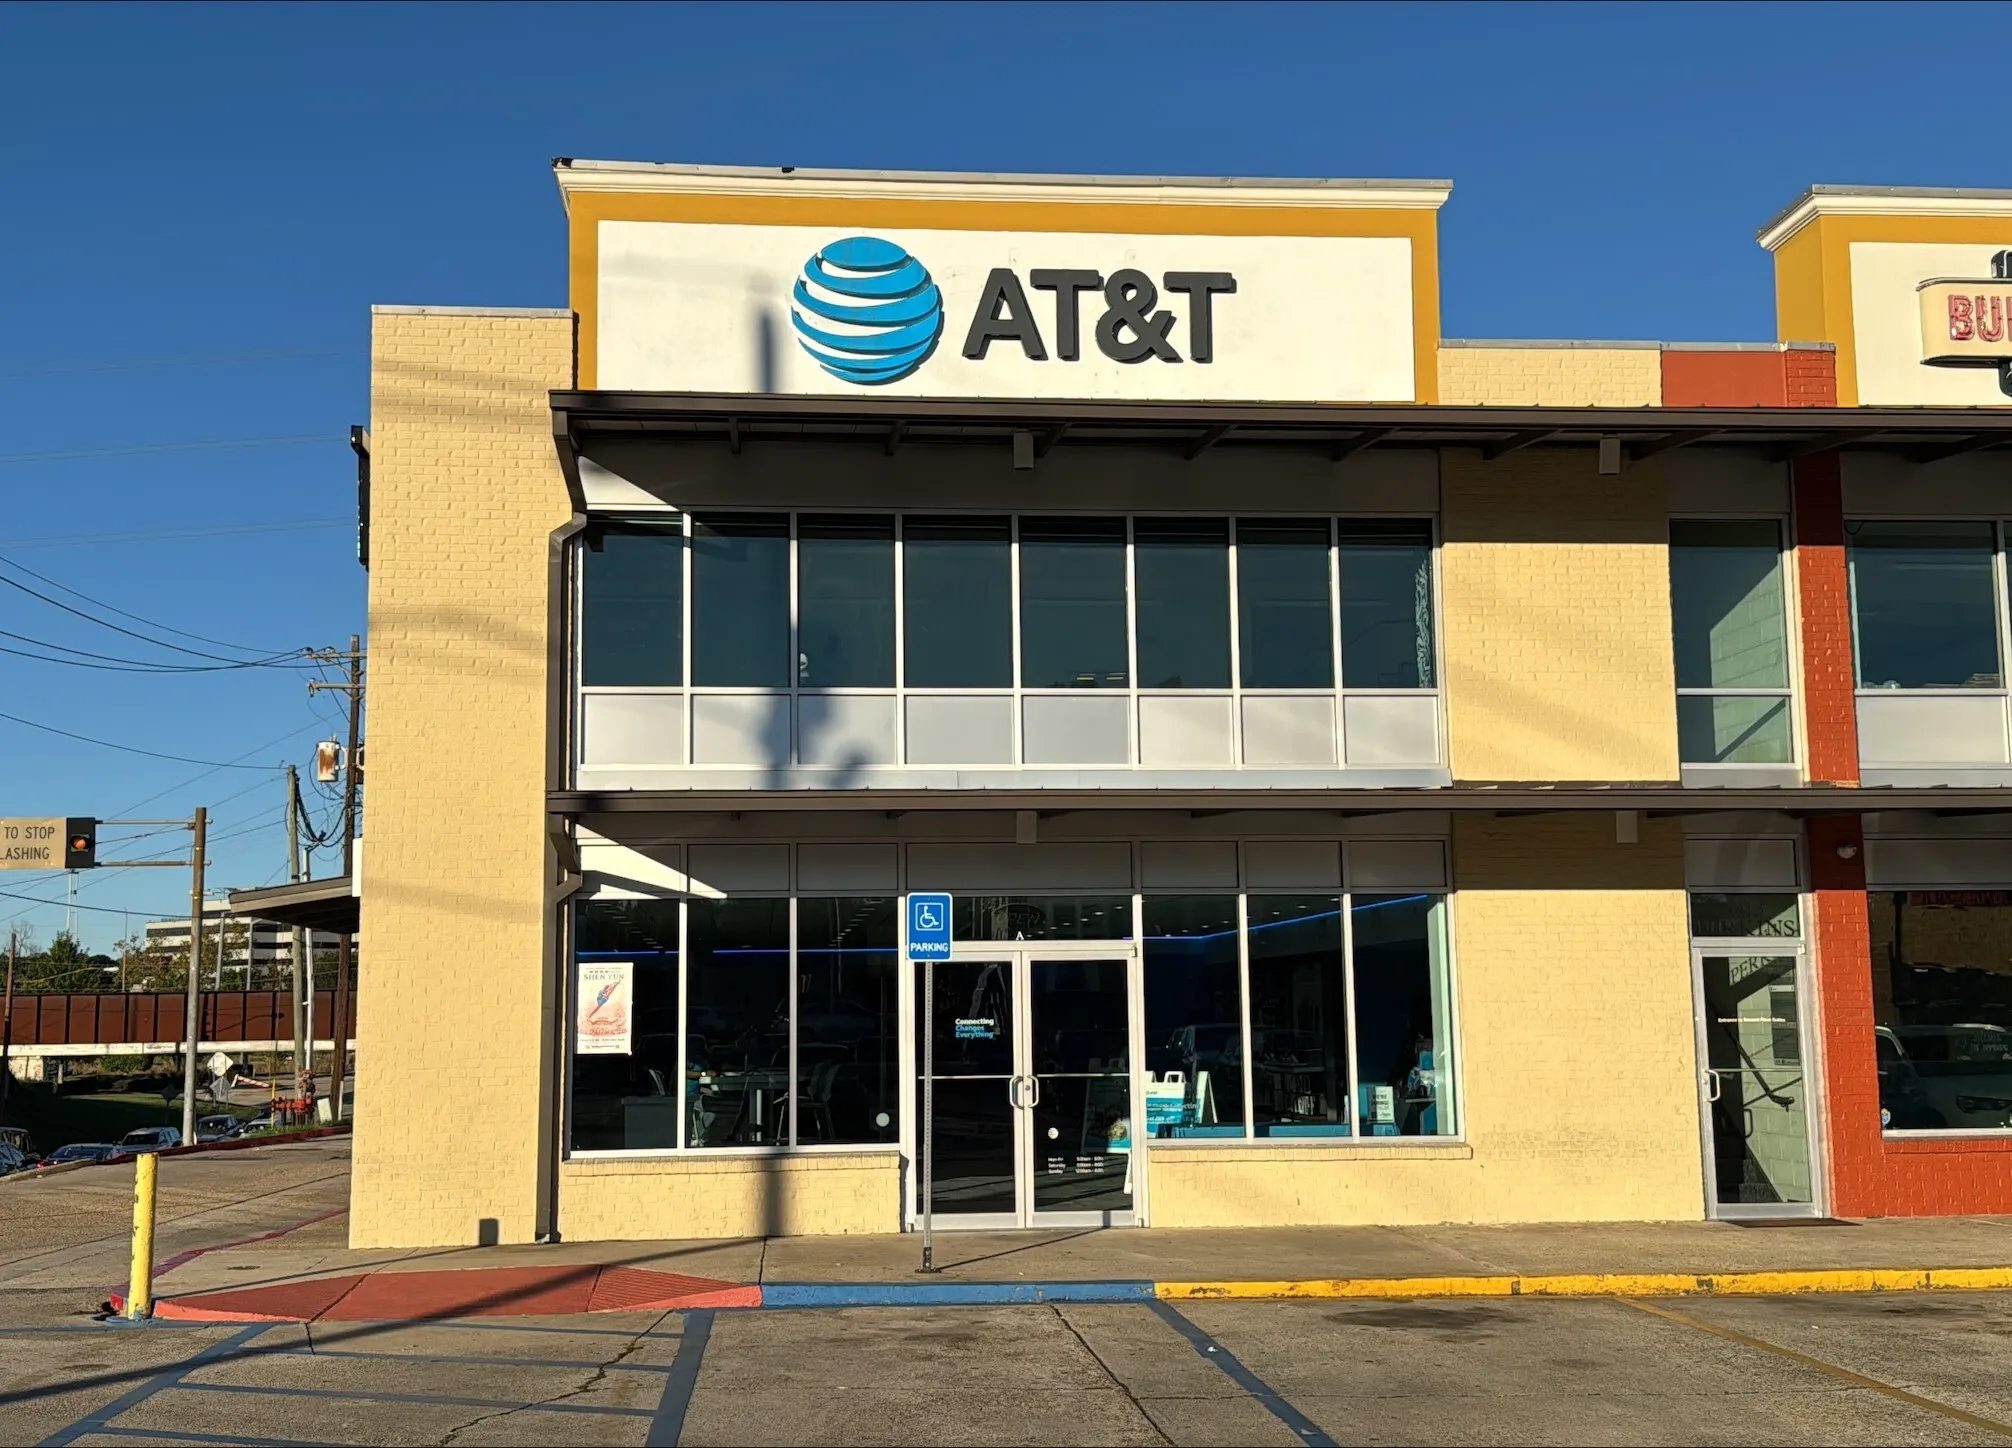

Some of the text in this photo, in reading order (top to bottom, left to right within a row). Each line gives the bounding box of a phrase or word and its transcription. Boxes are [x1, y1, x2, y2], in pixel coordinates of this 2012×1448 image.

[962, 268, 1237, 364] AT&T
[1947, 295, 2012, 342] BU
[4, 826, 55, 839] TO STOP
[1015, 931, 1025, 940] A
[910, 942, 949, 952] PARKING
[955, 1018, 994, 1026] Connecting
